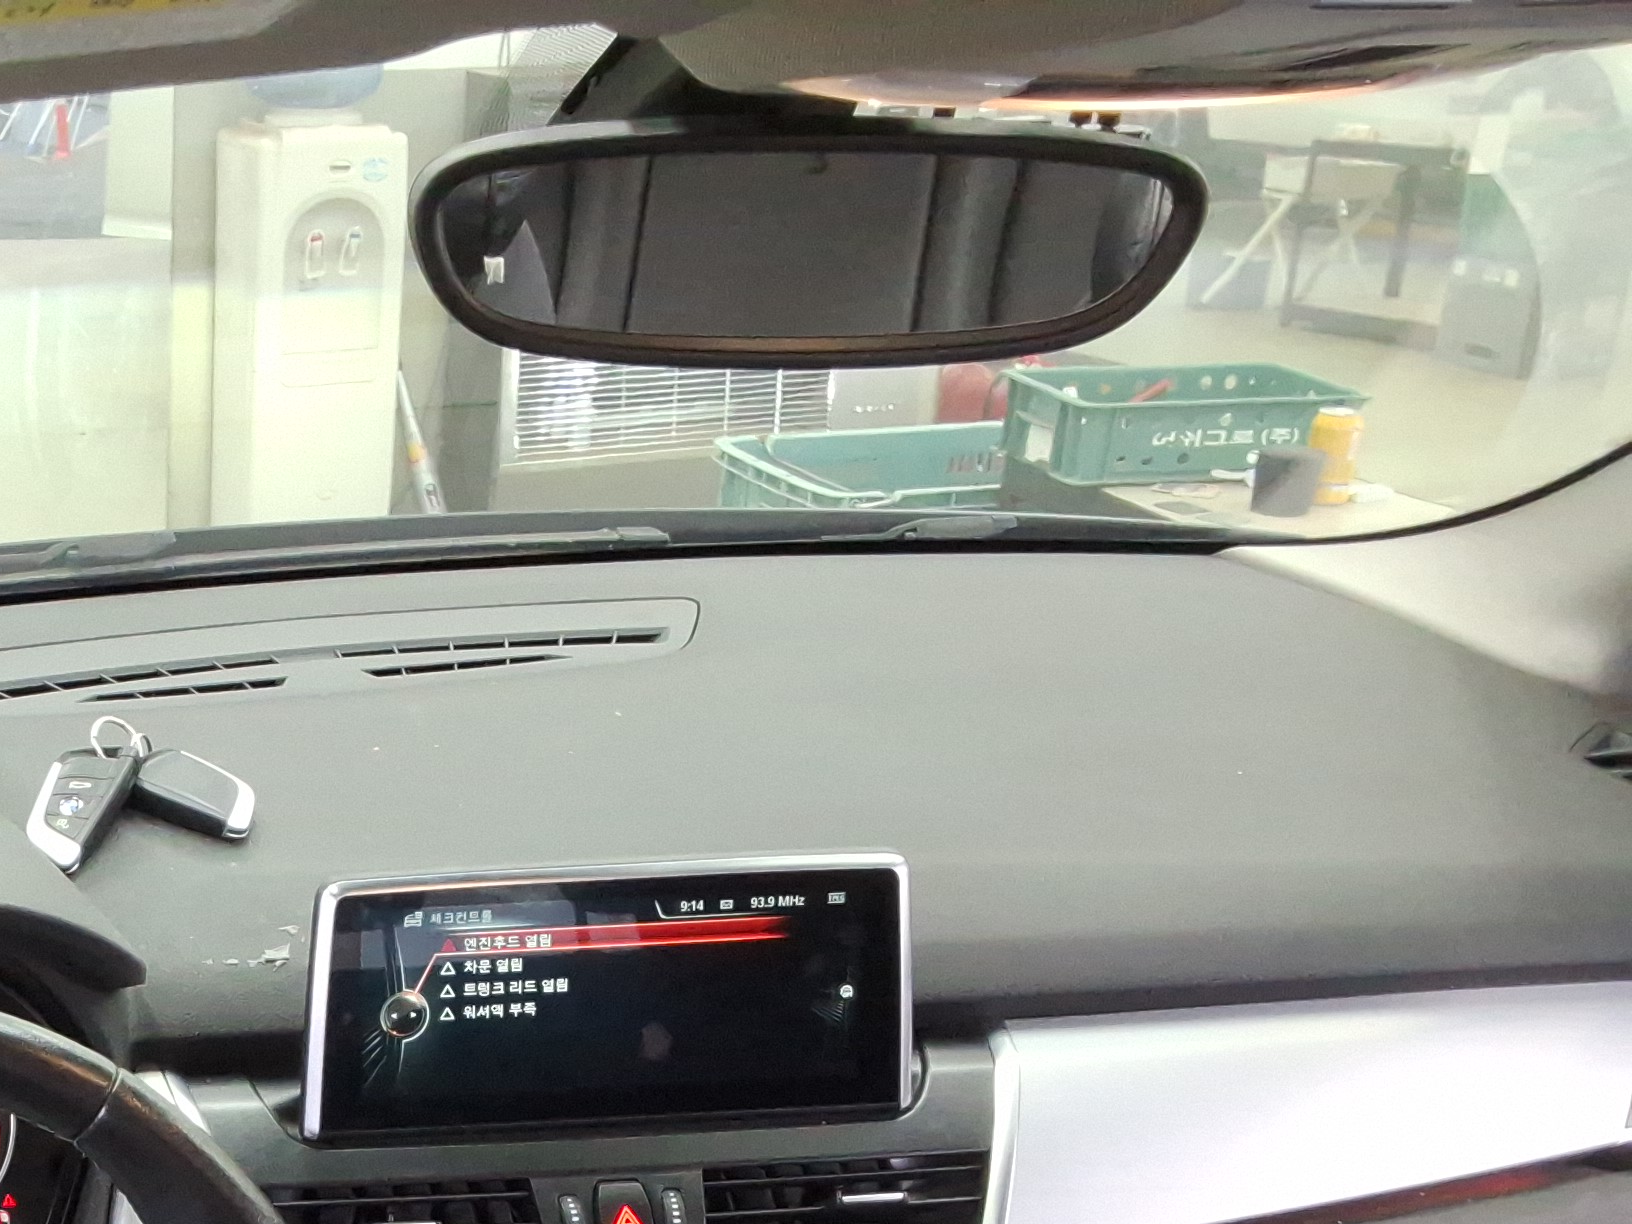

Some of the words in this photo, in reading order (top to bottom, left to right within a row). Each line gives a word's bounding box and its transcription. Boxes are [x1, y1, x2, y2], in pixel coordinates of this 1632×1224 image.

[680, 899, 704, 912] 9:14
[750, 896, 775, 908] 93.9
[778, 895, 805, 907] MHz
[463, 935, 521, 951] 엔진후드
[525, 933, 552, 948] 열림
[463, 959, 491, 974] 차문
[496, 957, 523, 973] 열림
[463, 981, 505, 997] 트렁크
[509, 980, 537, 994] 리드
[542, 978, 568, 993] 열림
[462, 1004, 505, 1019] 워셔액
[509, 1002, 537, 1018] 부족
